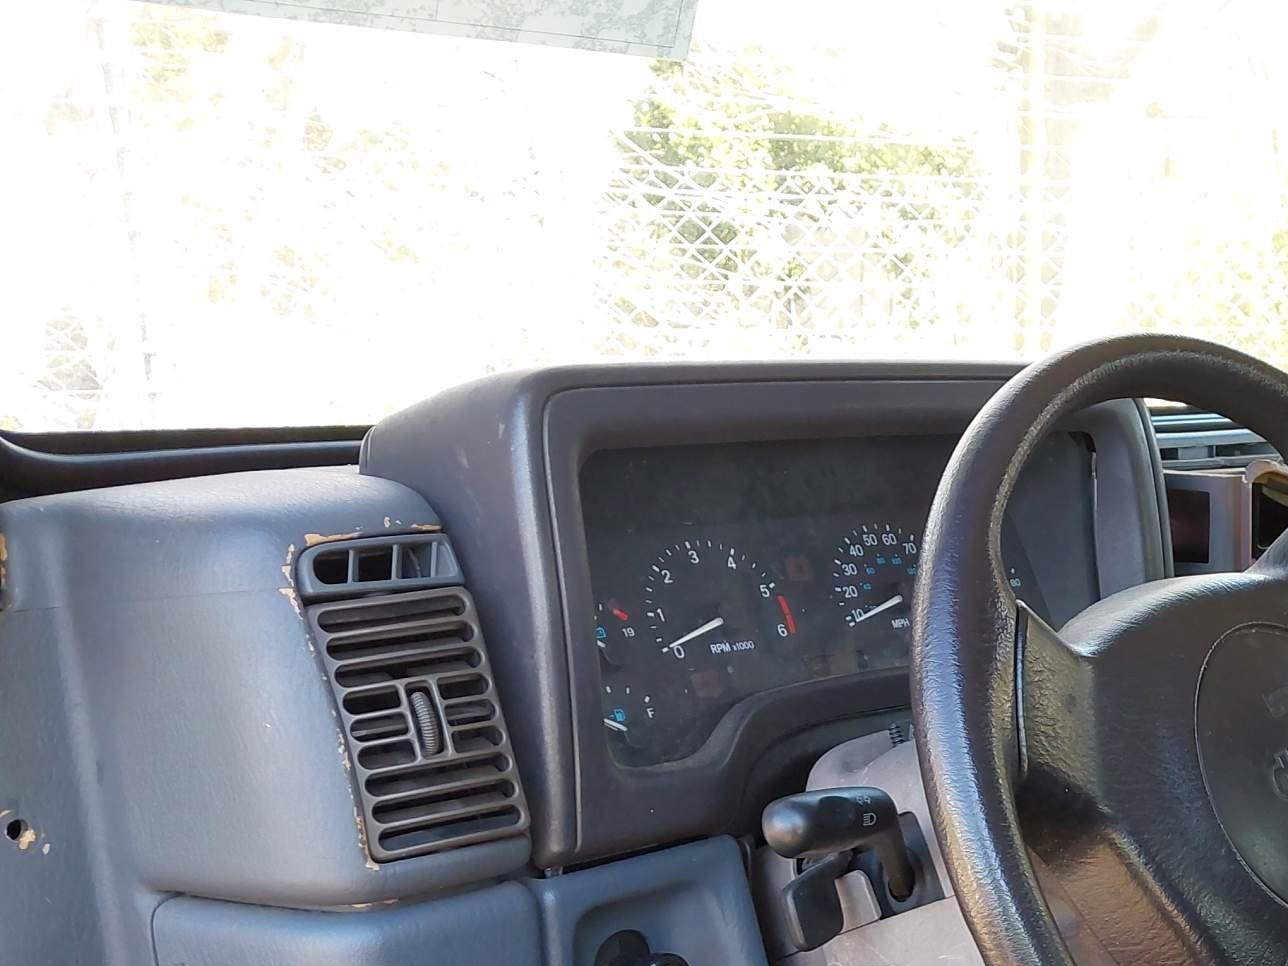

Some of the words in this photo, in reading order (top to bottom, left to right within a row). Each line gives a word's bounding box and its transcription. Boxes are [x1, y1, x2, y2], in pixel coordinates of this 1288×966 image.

[863, 534, 878, 546] 50
[881, 533, 897, 546] 60
[849, 544, 864, 557] 40
[902, 542, 917, 554] 70
[688, 550, 700, 564] 3
[727, 556, 737, 570] 4
[841, 563, 858, 576] 30
[661, 569, 673, 584] 2
[760, 584, 770, 598] 5
[843, 585, 858, 599] 20
[657, 609, 665, 622] 1
[891, 618, 911, 629] MPH
[621, 627, 635, 637] 19
[777, 624, 788, 637] 6
[673, 645, 685, 659] 0
[710, 641, 732, 655] RPM
[646, 707, 656, 719] F
